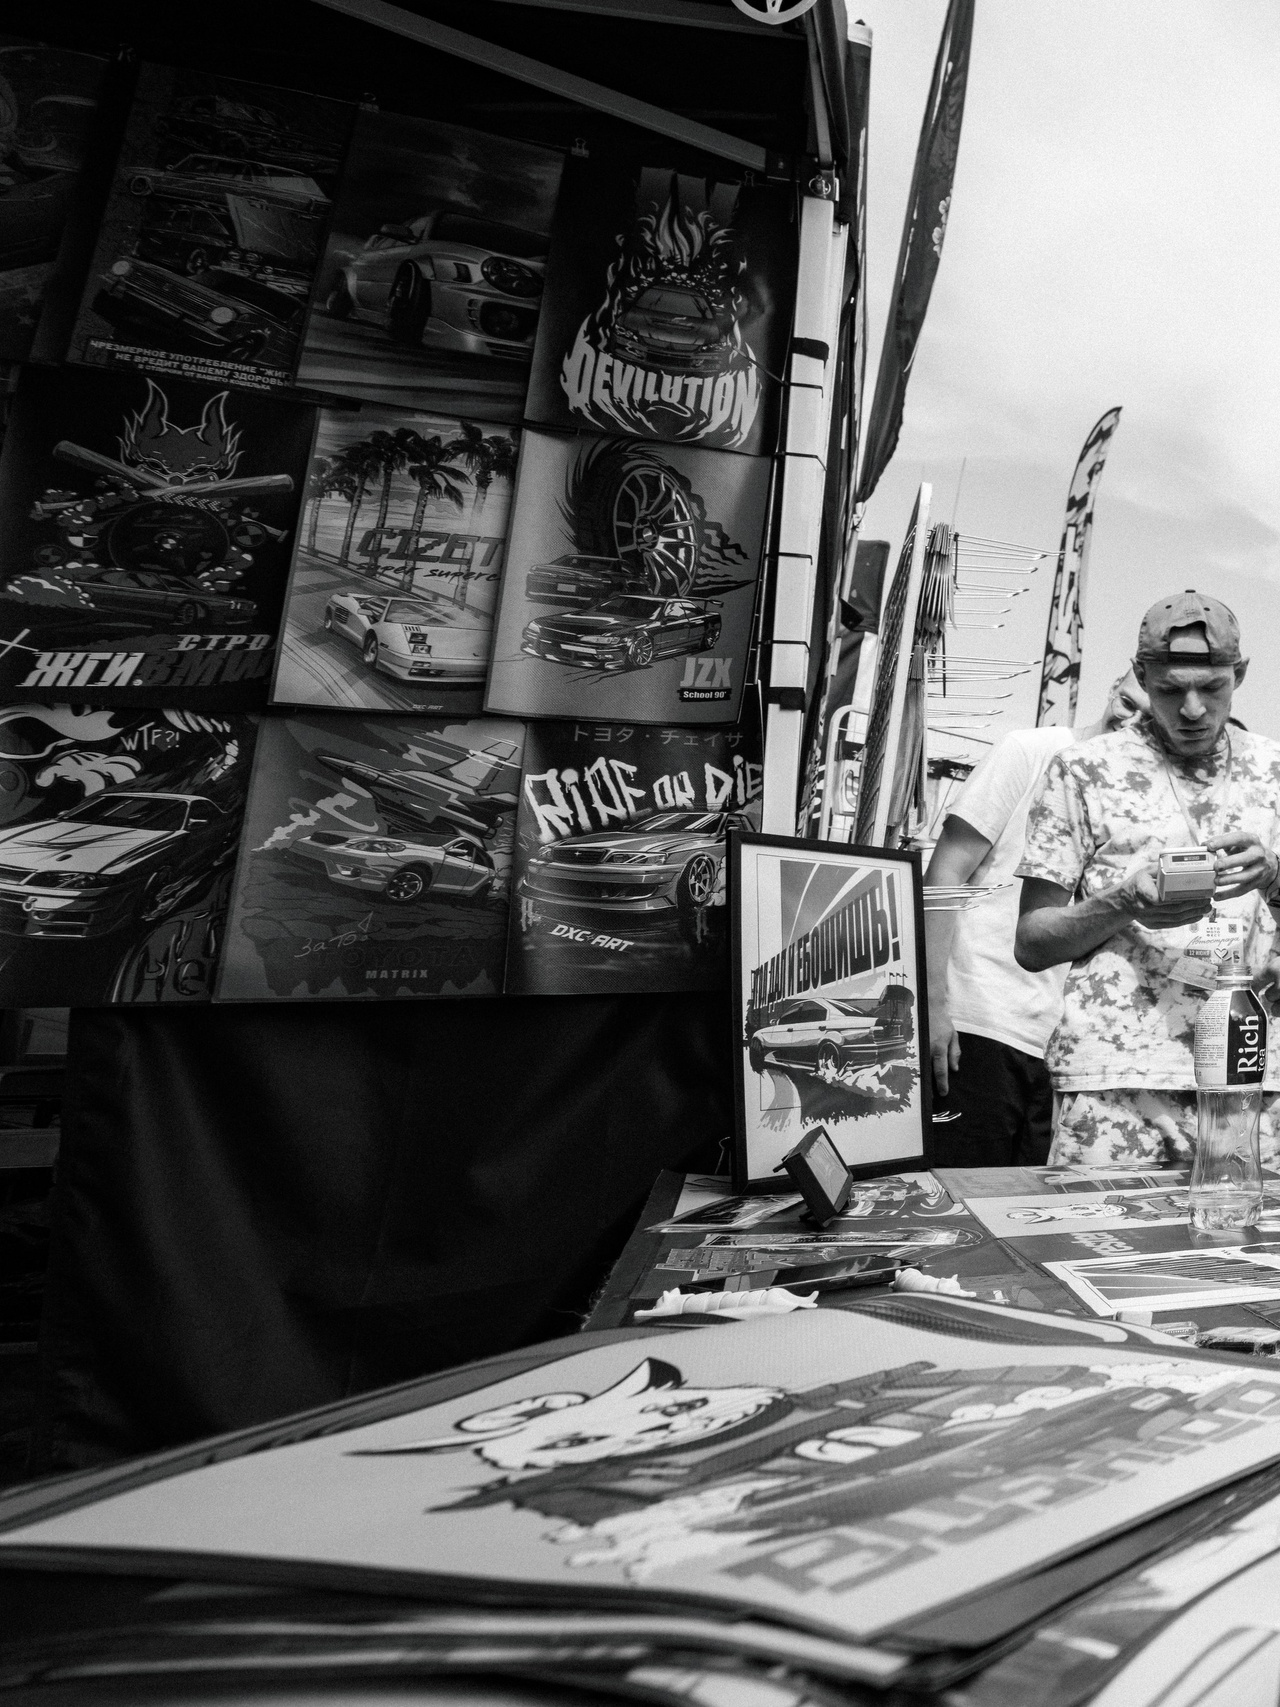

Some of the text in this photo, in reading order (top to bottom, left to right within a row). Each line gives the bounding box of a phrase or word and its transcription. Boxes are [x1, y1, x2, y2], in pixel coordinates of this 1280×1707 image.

[89, 339, 167, 359] ЧРЕЗМЕРНОЕ
[168, 352, 258, 374] УПОТРЕБЛЕНИЕ
[114, 352, 132, 361] НЕ
[133, 355, 181, 369] ВРЕДИТ
[182, 362, 231, 377] ВАШЕМУ
[560, 328, 763, 448] DEVILUTION
[680, 657, 733, 687] JZX
[683, 690, 713, 699] School
[120, 721, 180, 751] WTF?!
[551, 924, 635, 952] DXC ART
[365, 969, 429, 979] MATRIX
[1237, 1014, 1260, 1074] Rich
[1258, 1048, 1267, 1072] tea
